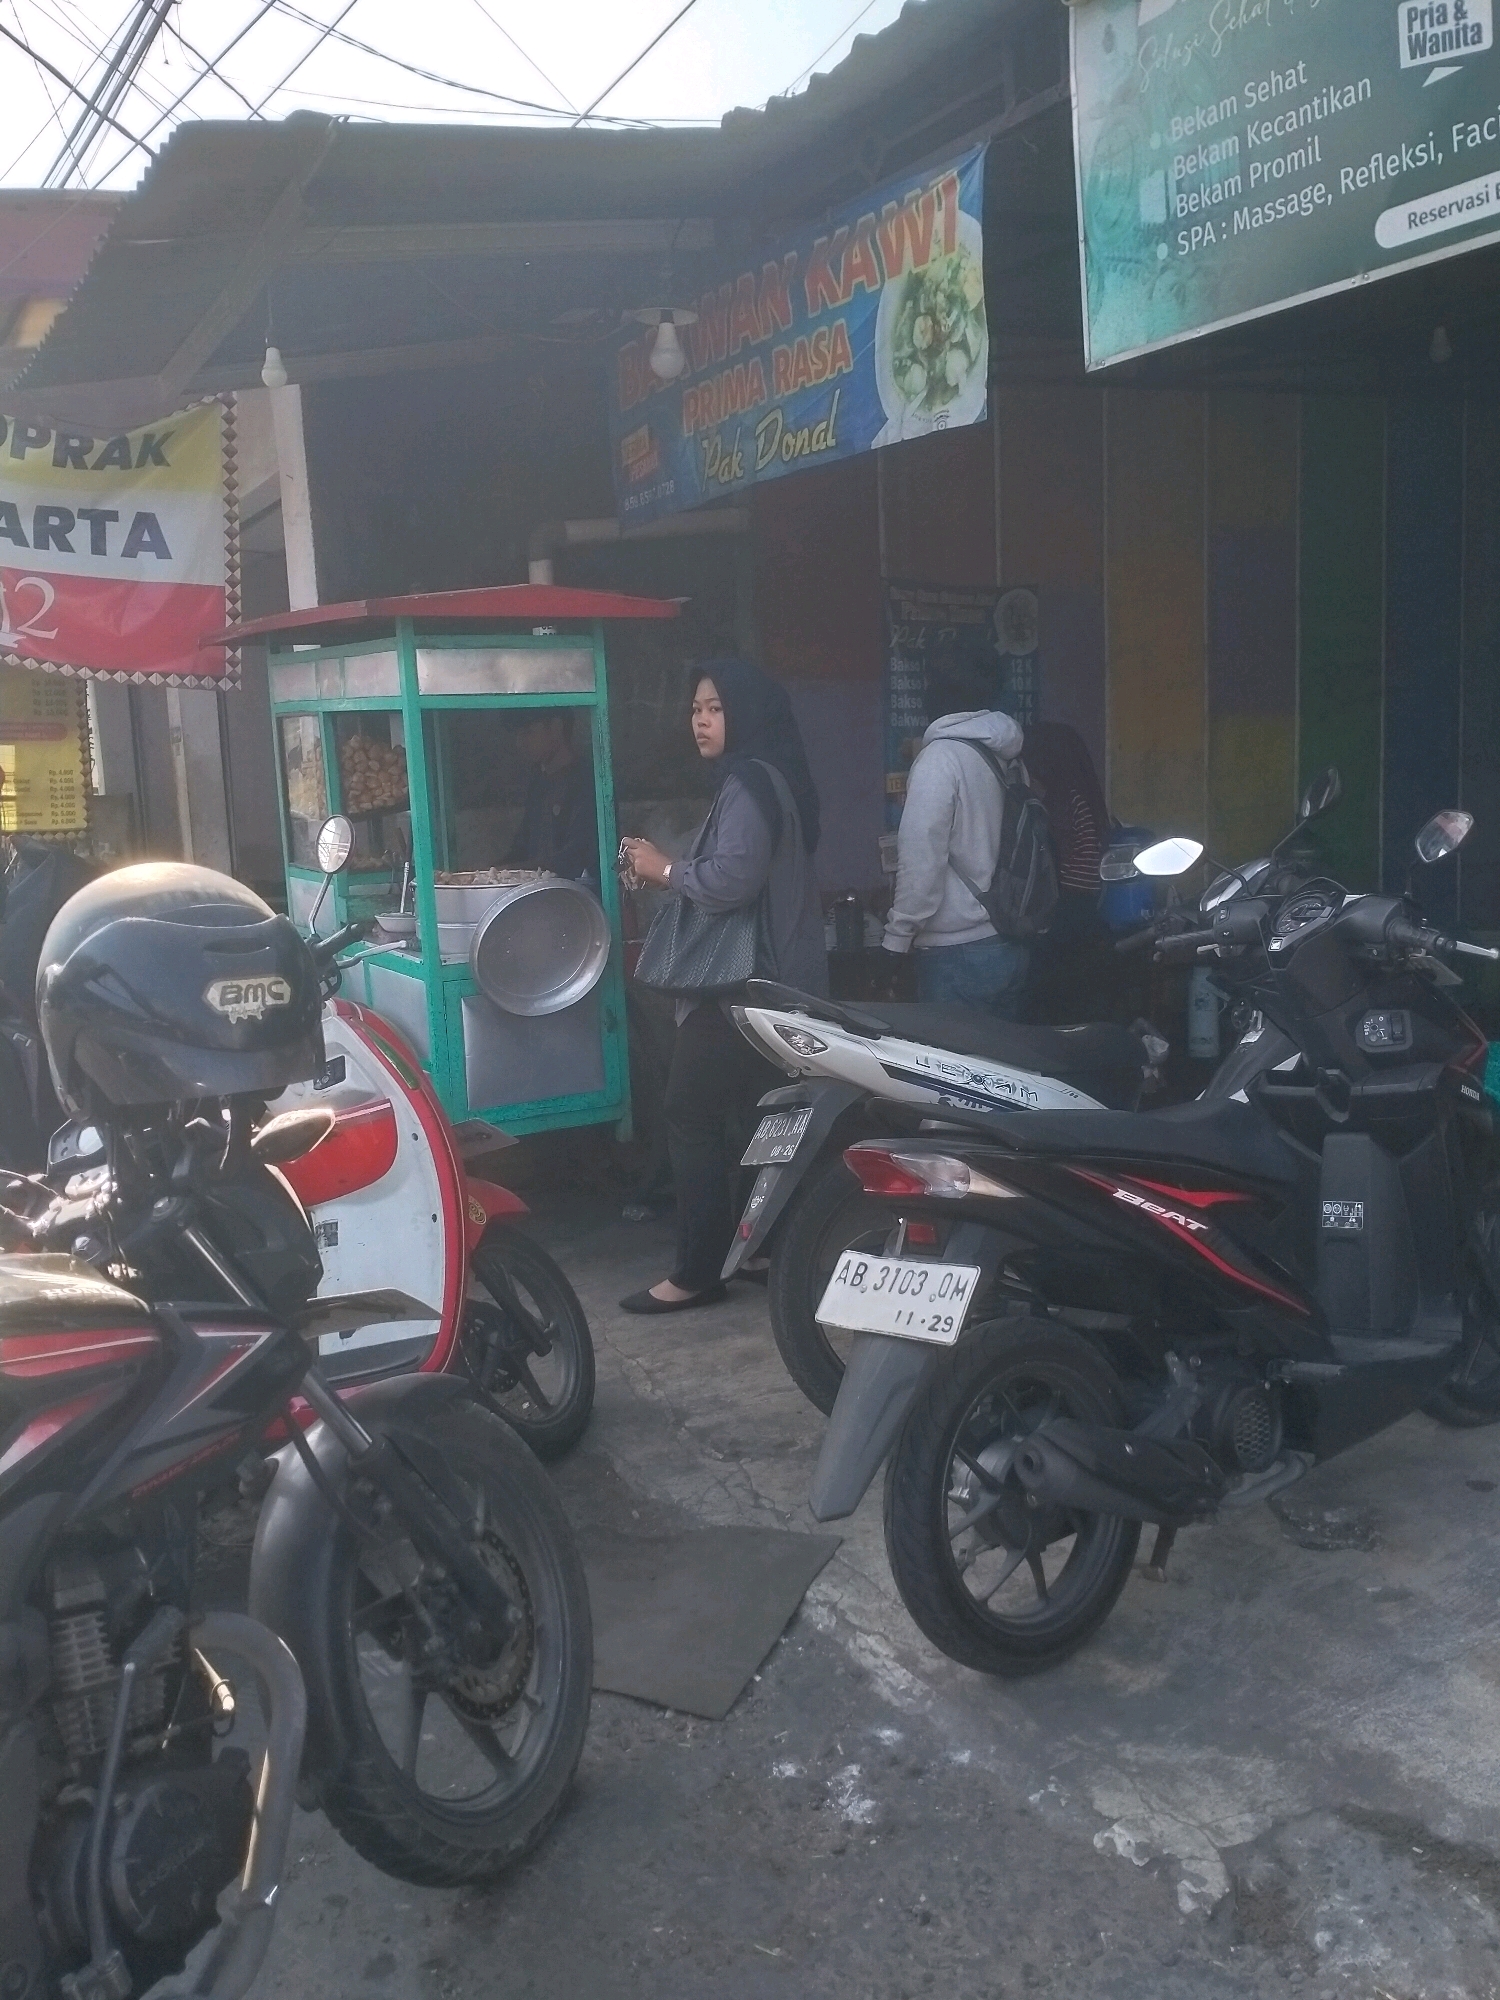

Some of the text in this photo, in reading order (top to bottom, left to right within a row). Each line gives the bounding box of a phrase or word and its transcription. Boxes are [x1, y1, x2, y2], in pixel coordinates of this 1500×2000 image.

[1407, 0, 1468, 34] Pria &
[1407, 20, 1483, 61] Wanita
[1170, 59, 1308, 142] Bekam Sehat
[1173, 76, 1372, 181] Bekam Kecantikan
[1176, 134, 1322, 219] Bekam Promil
[1177, 220, 1217, 256] SPA
[1233, 182, 1334, 236] Massage,
[1339, 130, 1444, 195] Refleksi,
[1407, 182, 1491, 231] Reservasi
[804, 168, 960, 319] KAWI
[682, 318, 853, 438] PRIMA RASA
[0, 417, 176, 471] PRAK
[700, 426, 744, 492] Pak
[754, 387, 841, 472] Donal
[0, 499, 173, 560] ARTA
[219, 980, 285, 1007] BMC
[834, 1258, 869, 1287] AB
[872, 1264, 929, 1297] 3103
